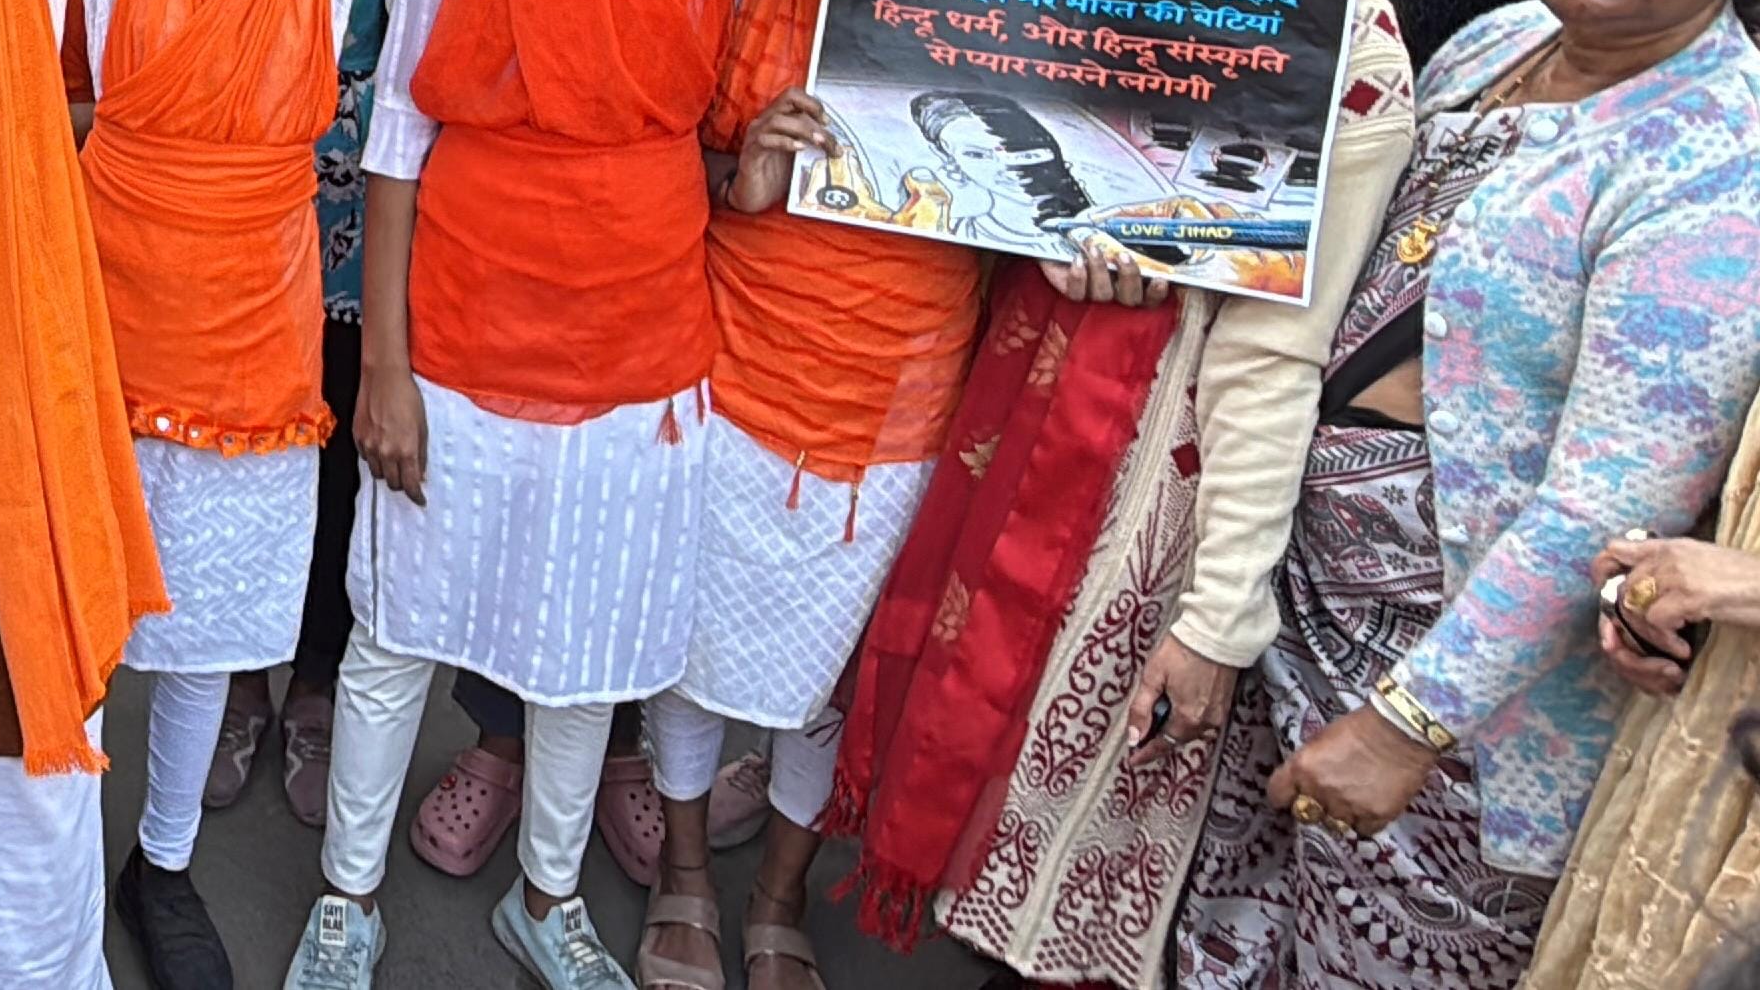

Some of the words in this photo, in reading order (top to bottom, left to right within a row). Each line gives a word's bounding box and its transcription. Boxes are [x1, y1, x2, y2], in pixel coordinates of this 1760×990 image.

[1141, 0, 1187, 25] की
[924, 38, 961, 67] से
[961, 49, 1030, 77] प्यार
[1032, 59, 1111, 89] करने
[1022, 14, 1088, 50] और
[1165, 35, 1291, 80] संस्कृति
[1120, 223, 1164, 236] LOVE
[1173, 225, 1233, 240] JIHAD
